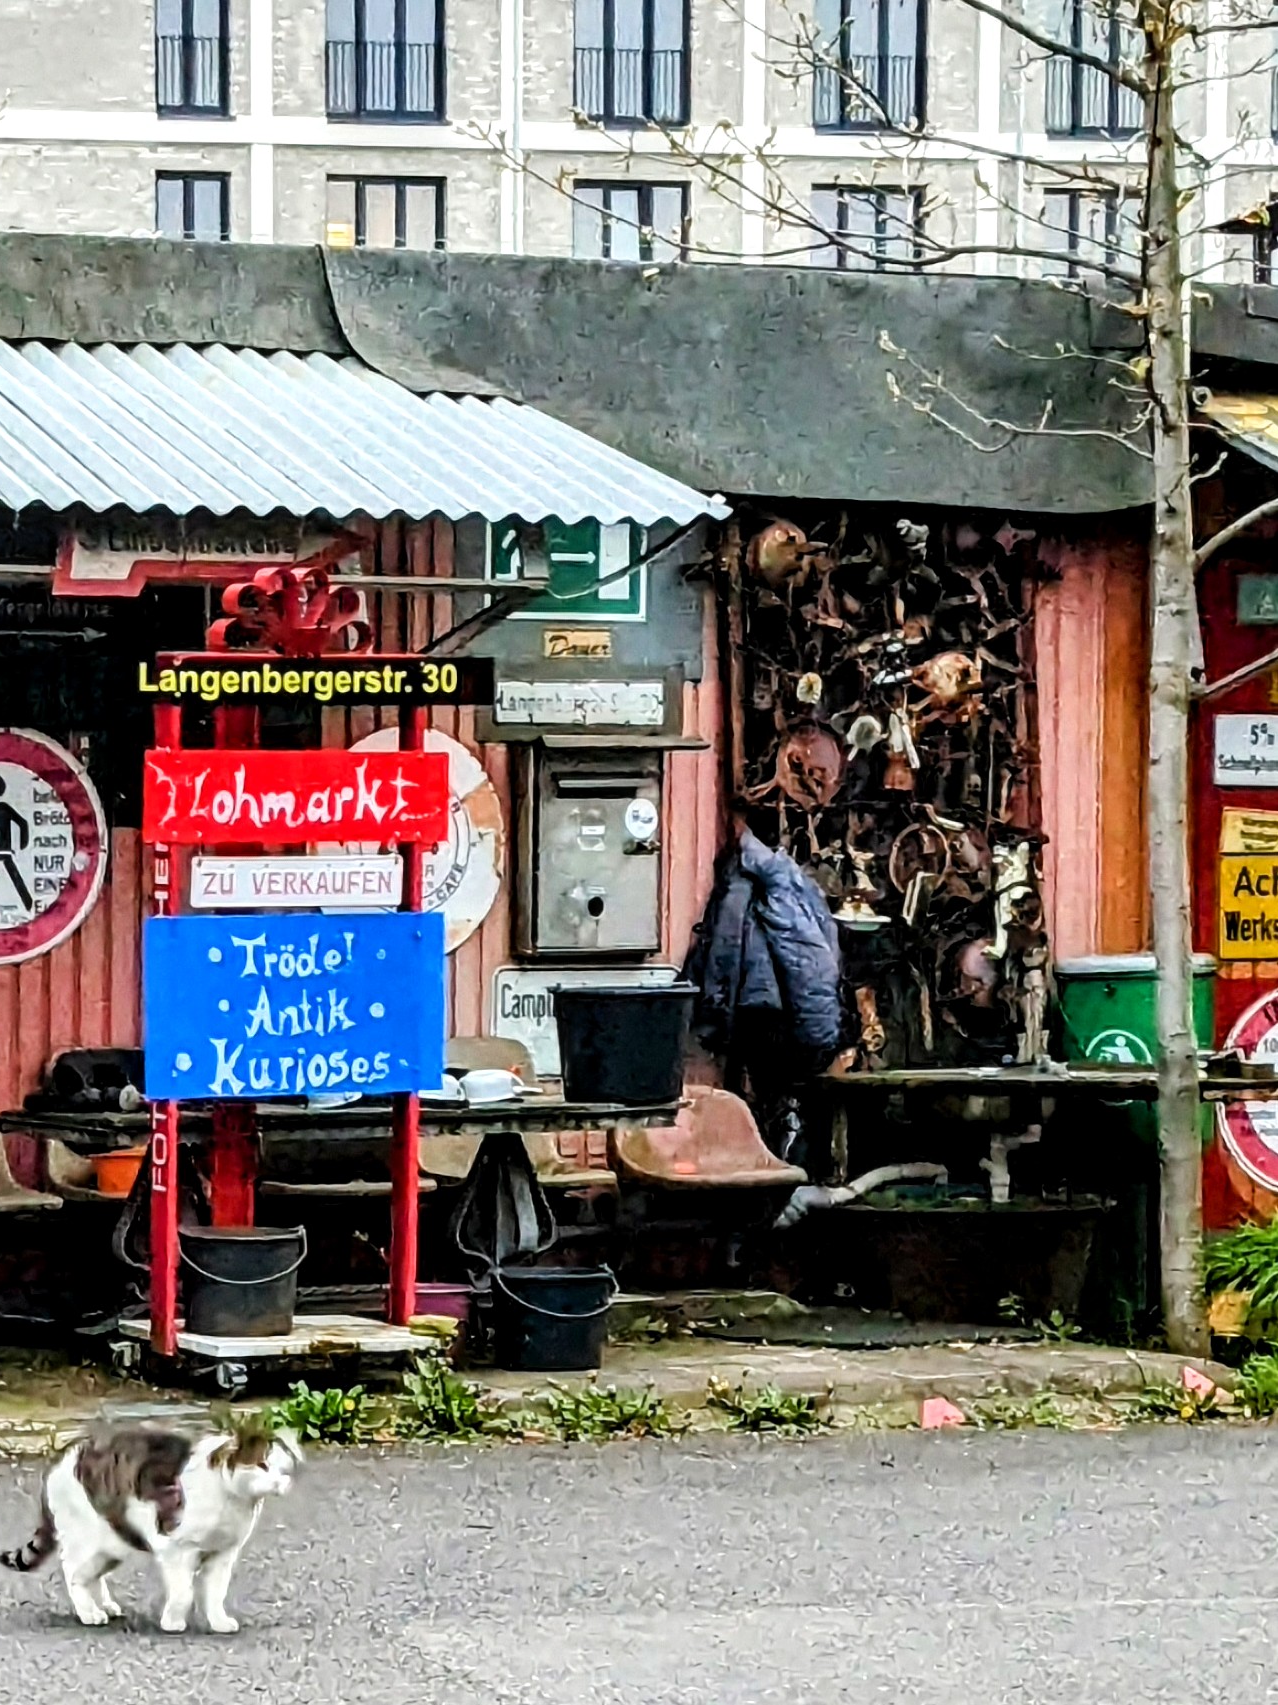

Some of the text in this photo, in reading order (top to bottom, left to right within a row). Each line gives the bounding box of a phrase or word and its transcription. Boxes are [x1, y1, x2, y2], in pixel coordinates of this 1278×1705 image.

[138, 661, 459, 700] Langenbergerstr. 30
[33, 855, 65, 873] NUR
[202, 870, 234, 897] ZU
[252, 868, 393, 897] VERKAUFEN
[244, 984, 357, 1038] Antik
[208, 1037, 392, 1096] Kurioses
